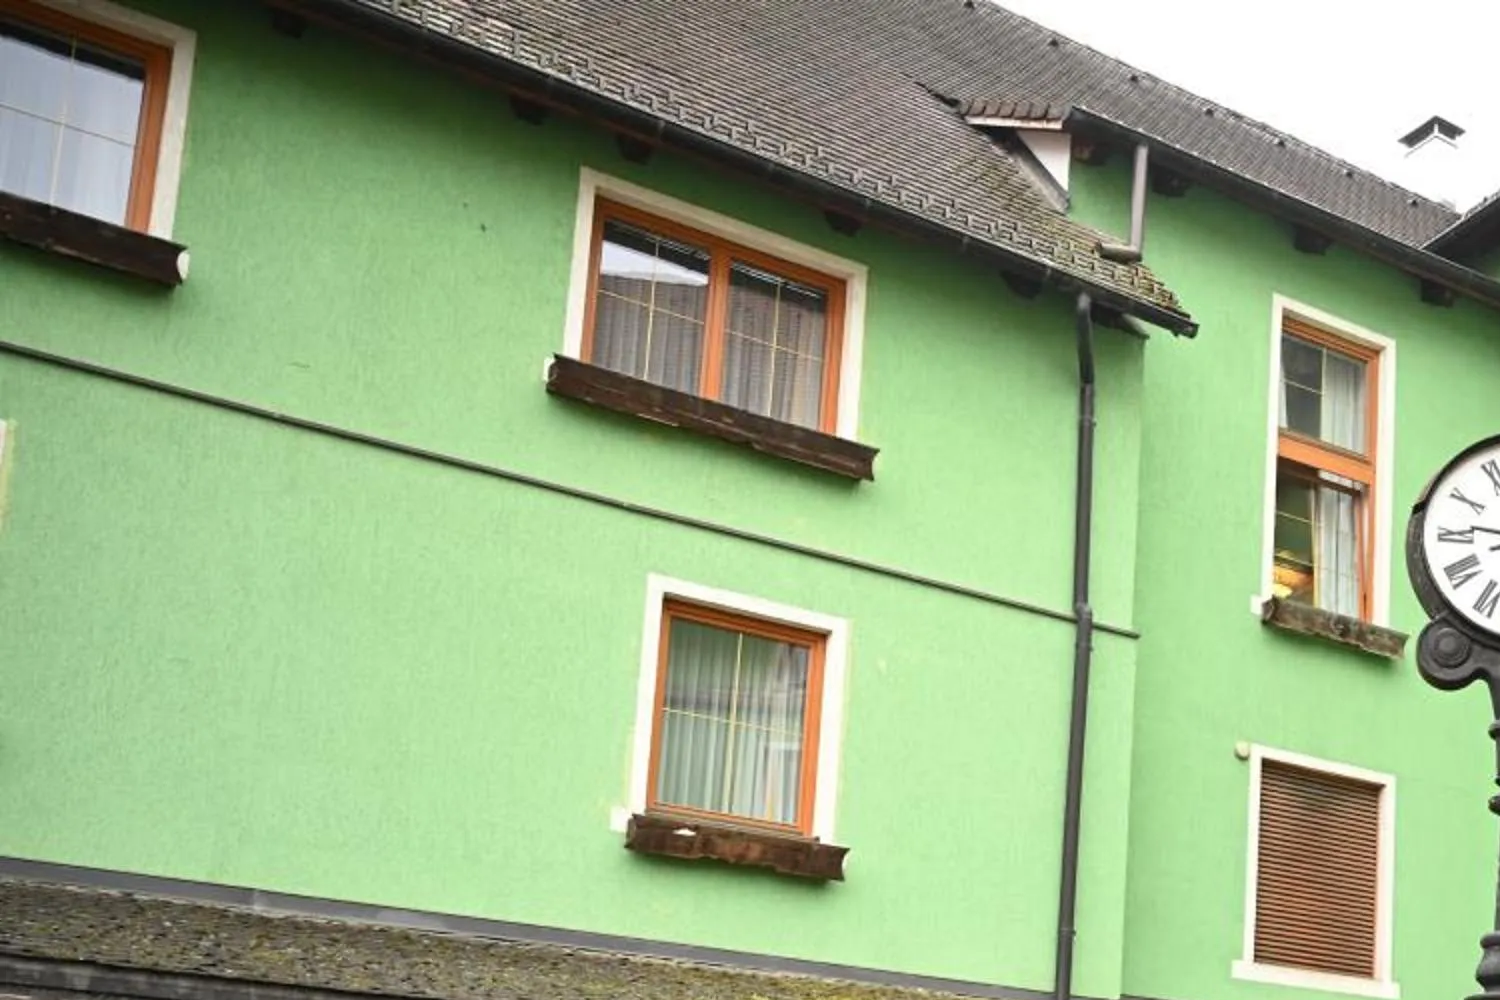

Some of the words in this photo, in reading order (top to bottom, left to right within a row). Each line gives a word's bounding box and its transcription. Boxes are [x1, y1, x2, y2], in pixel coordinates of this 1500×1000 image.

[1449, 487, 1486, 515] X
[1437, 526, 1474, 544] IX
[1443, 553, 1484, 590] VIII
